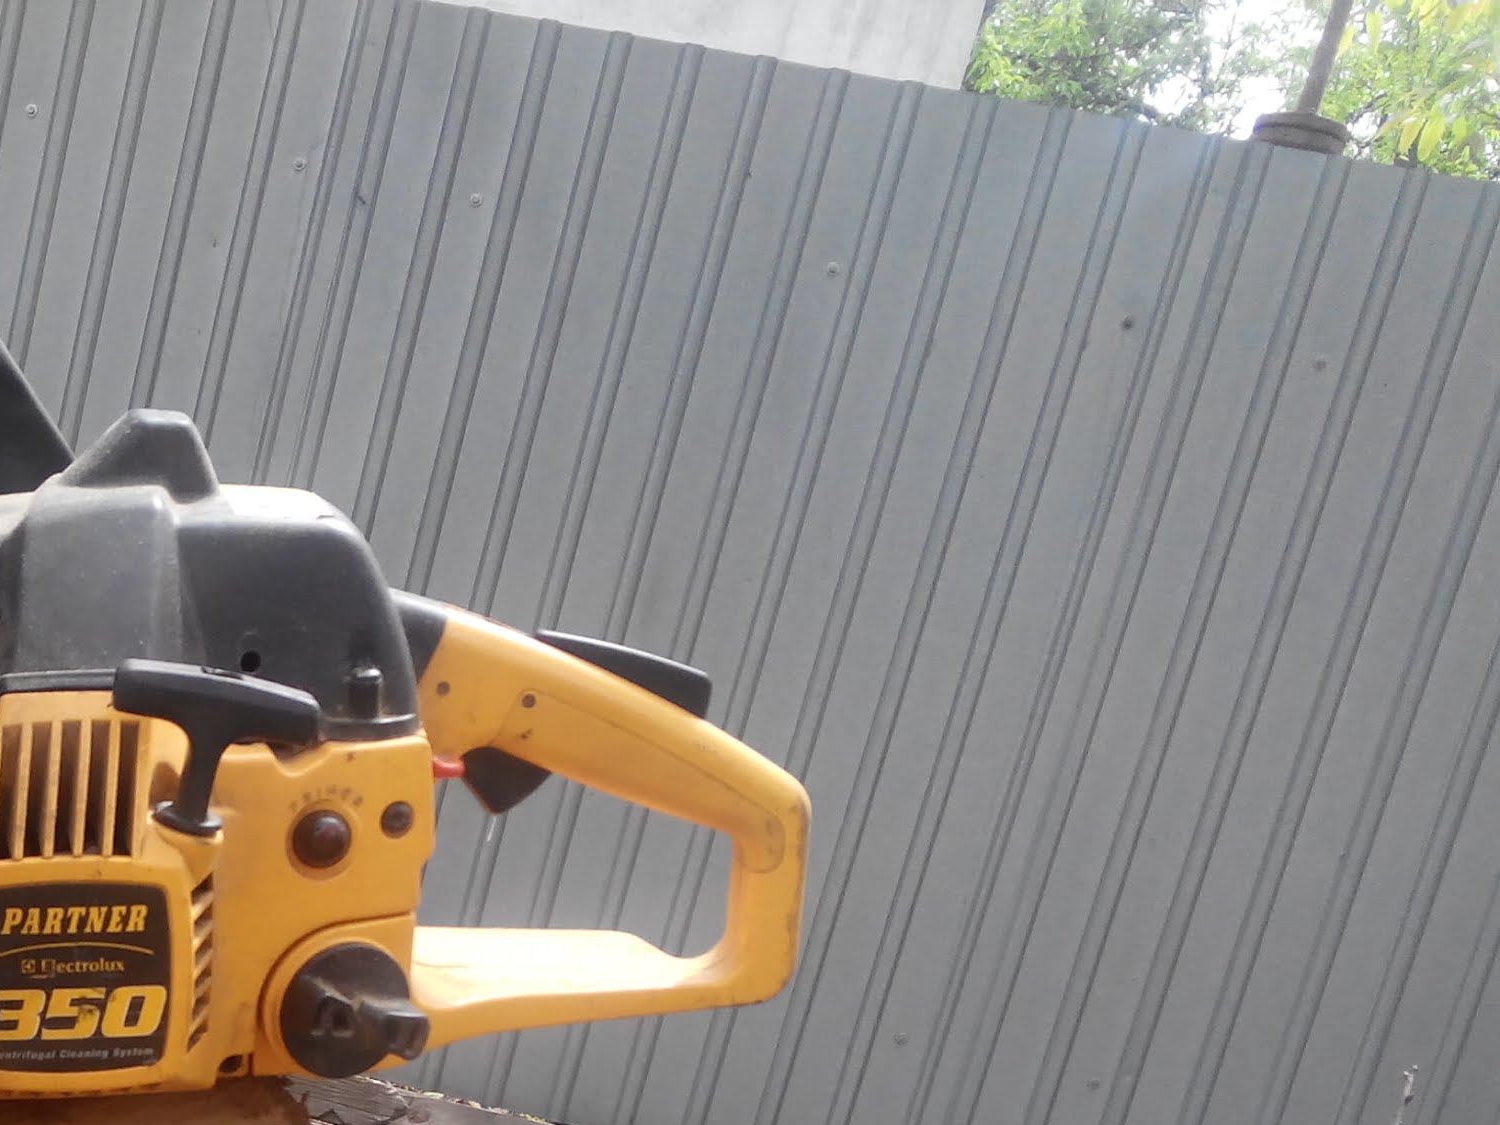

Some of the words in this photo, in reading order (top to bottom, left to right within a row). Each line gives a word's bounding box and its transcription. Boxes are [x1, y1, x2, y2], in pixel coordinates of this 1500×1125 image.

[1, 904, 149, 936] PARTNER
[41, 957, 125, 974] Electrolux
[59, 1049, 109, 1059] Cleaning
[112, 1047, 154, 1058] System
